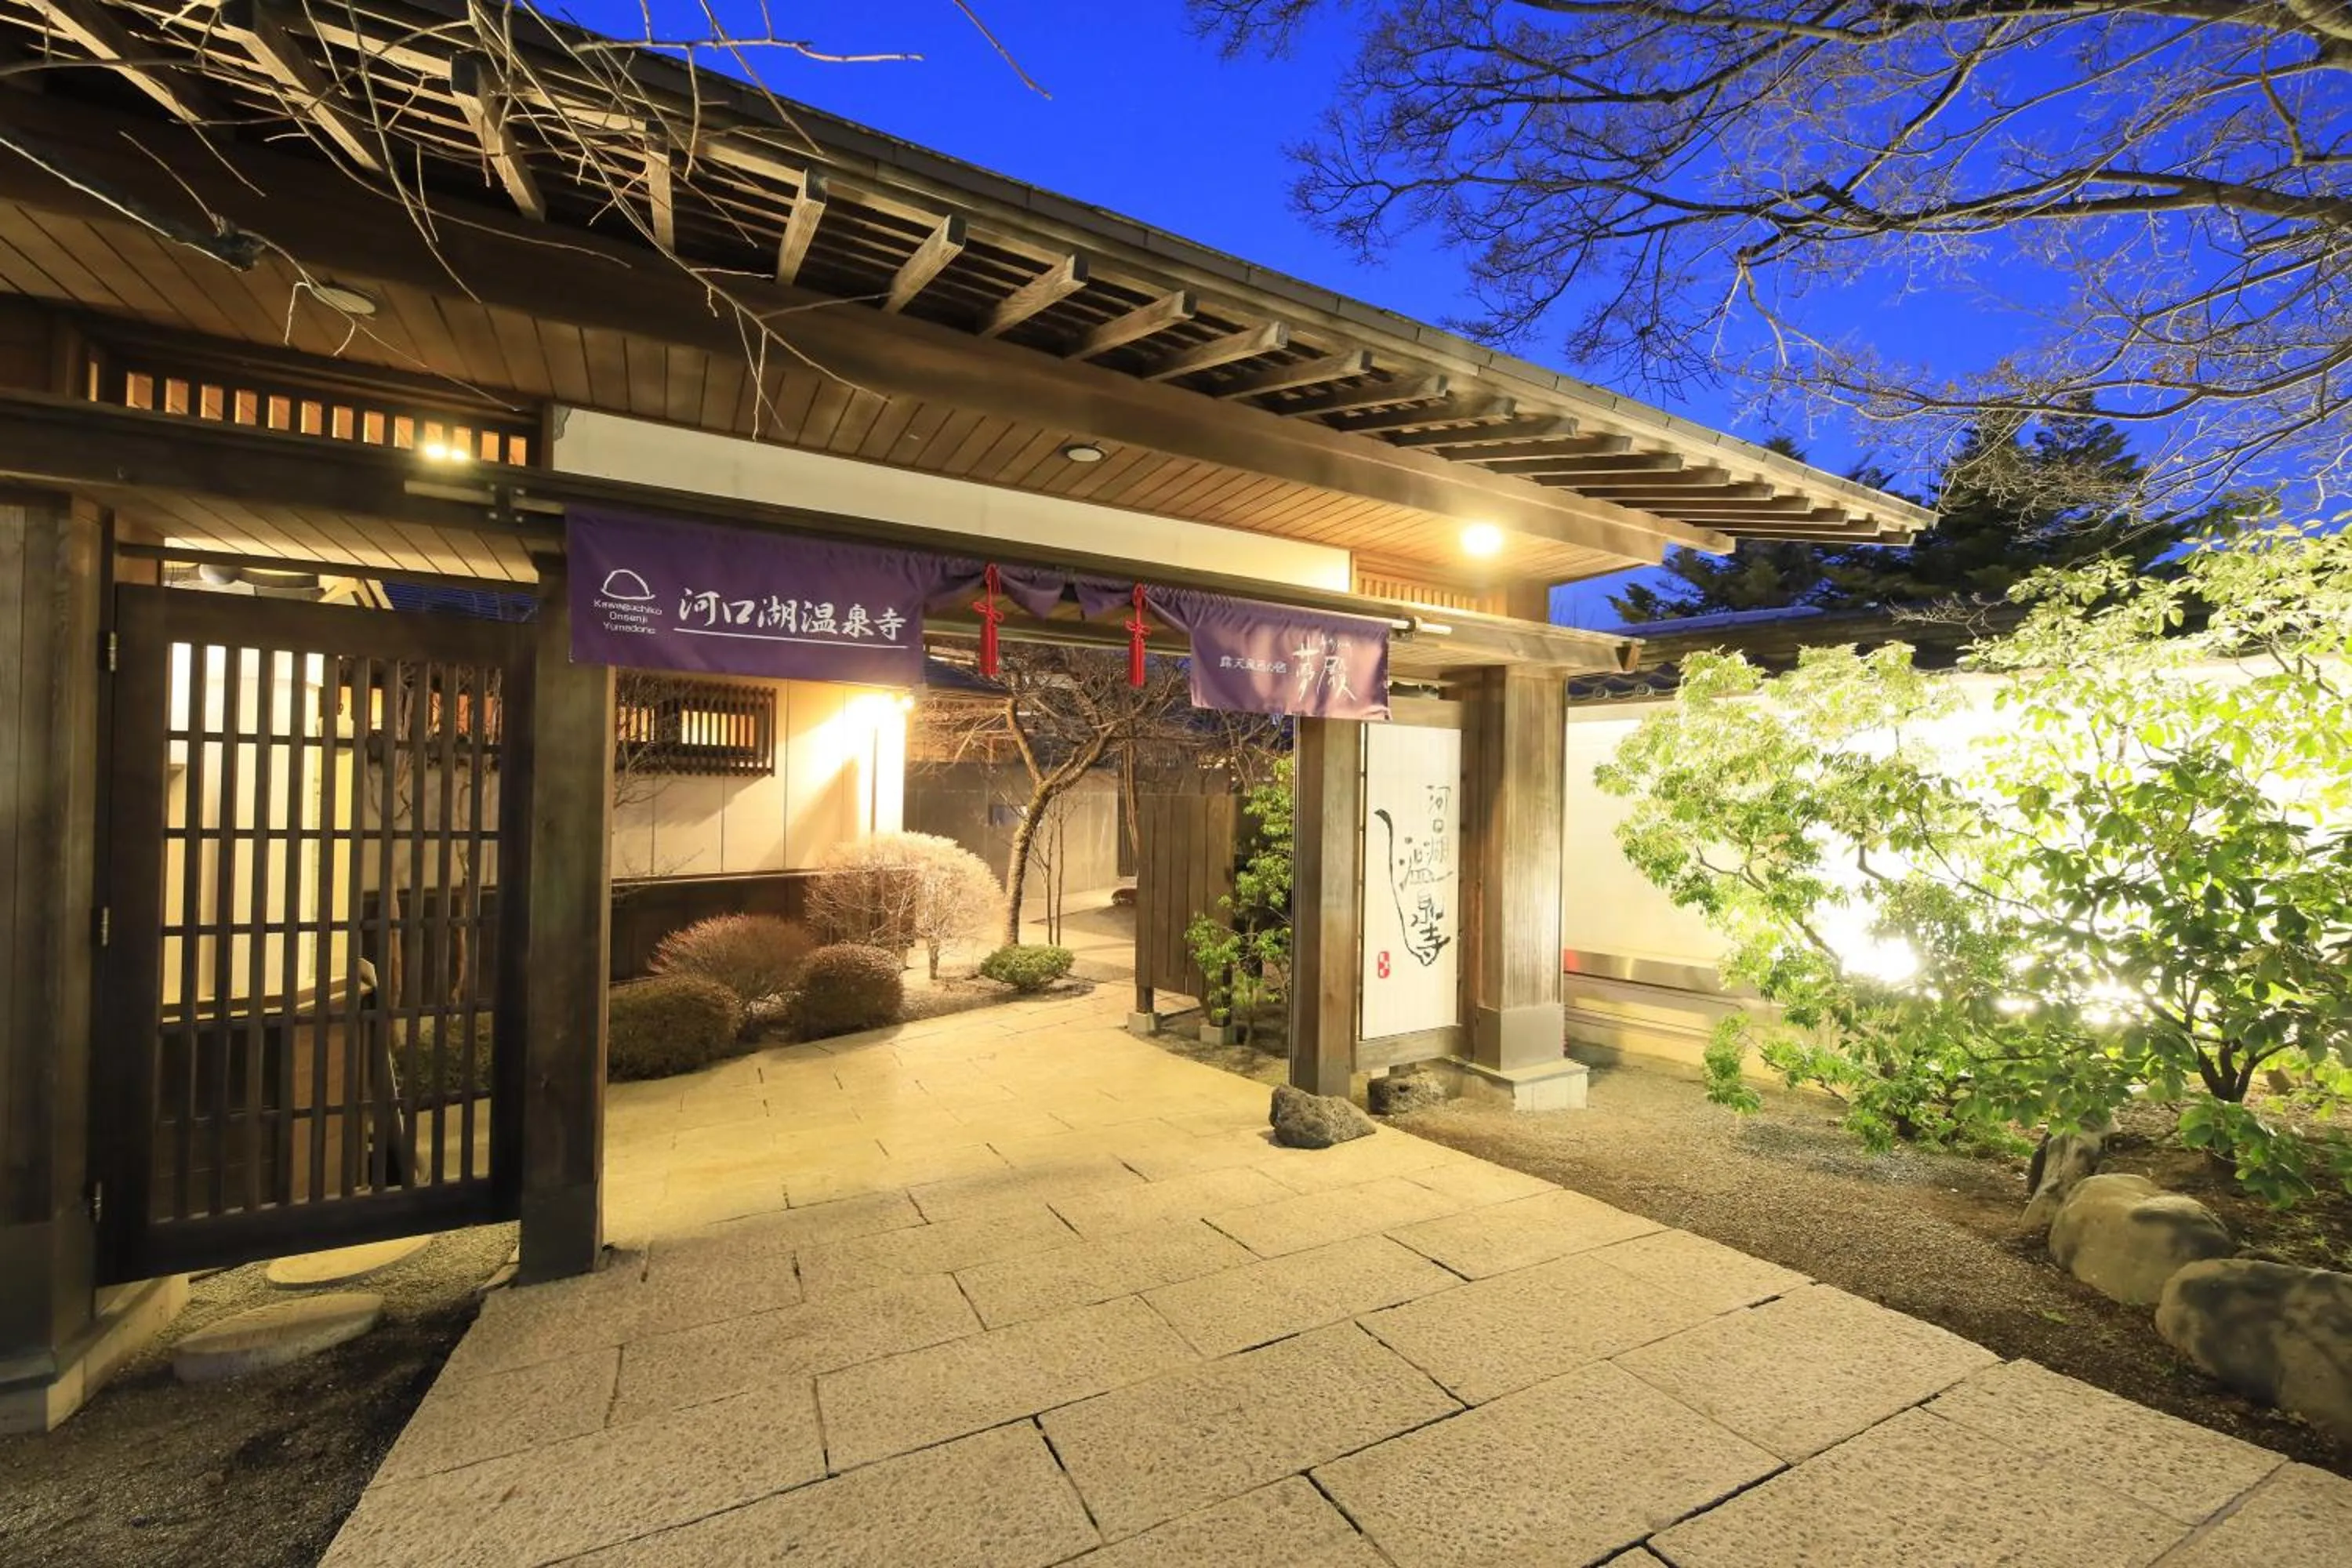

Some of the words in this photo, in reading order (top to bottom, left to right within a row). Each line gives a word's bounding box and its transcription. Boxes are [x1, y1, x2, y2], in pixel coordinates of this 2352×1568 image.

[679, 588, 906, 641] 河口湖温泉寺
